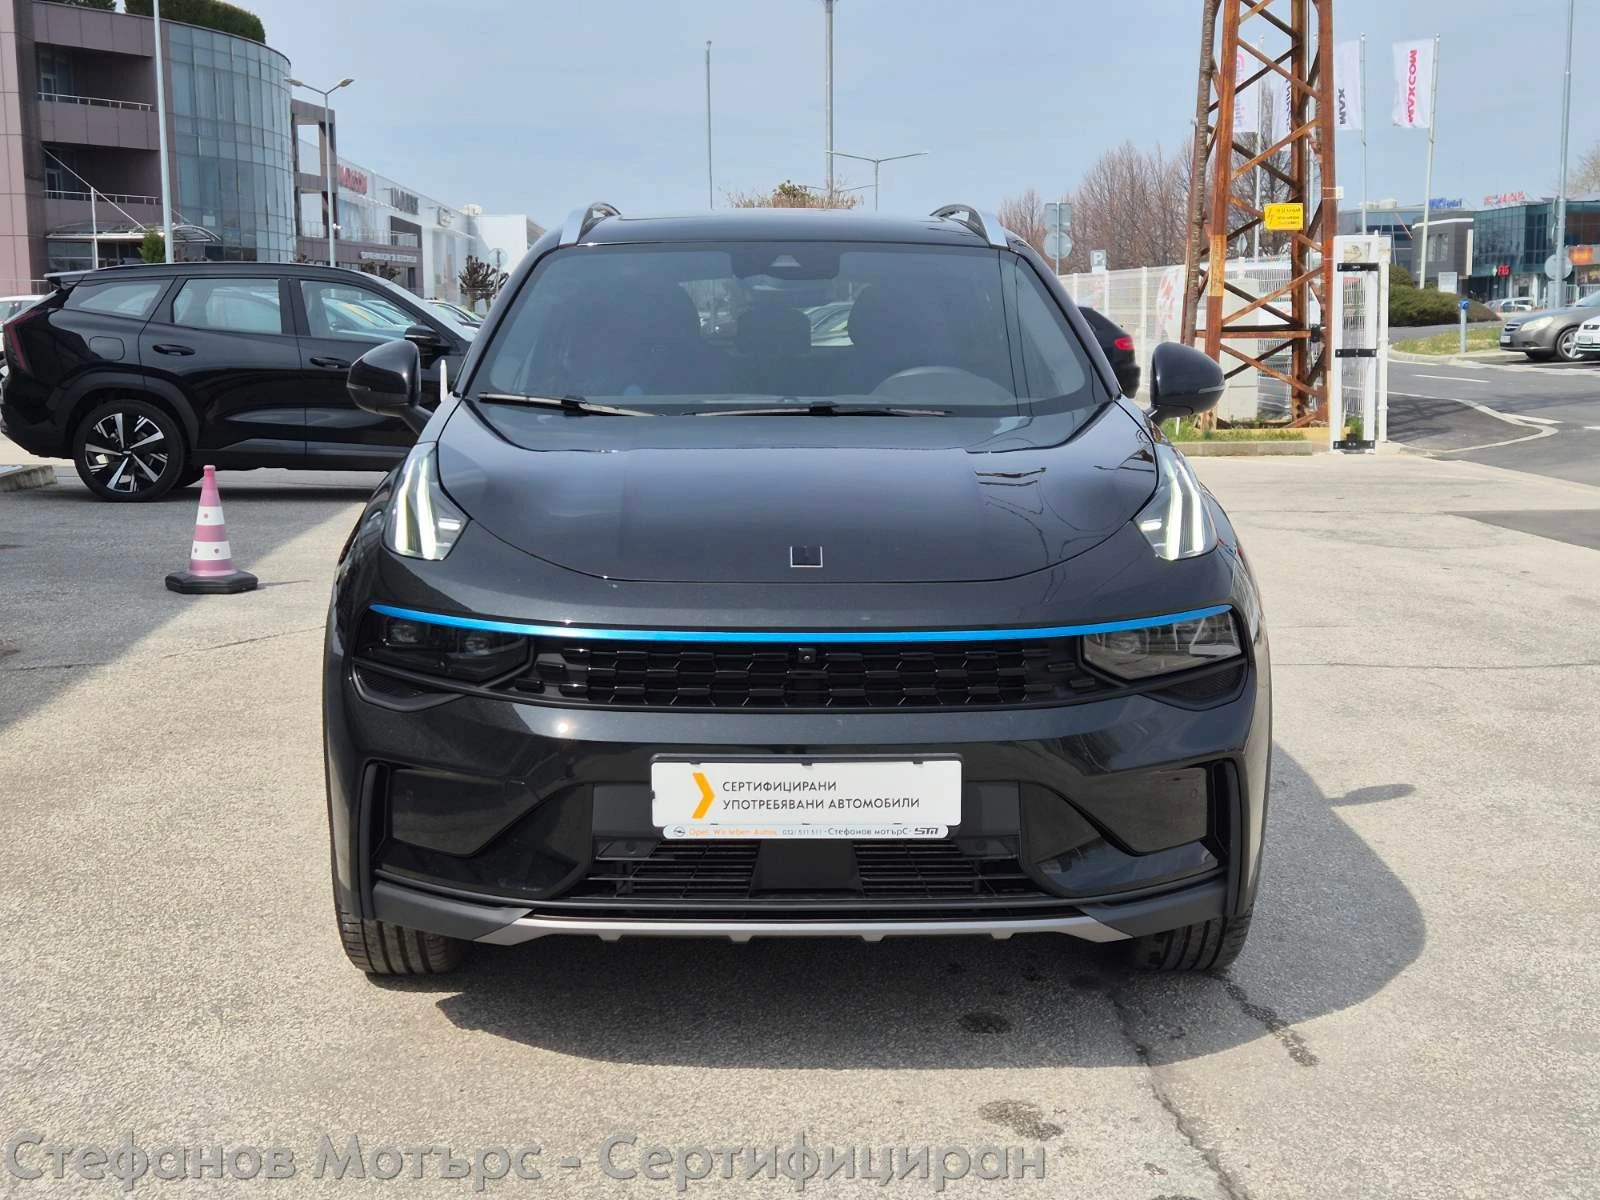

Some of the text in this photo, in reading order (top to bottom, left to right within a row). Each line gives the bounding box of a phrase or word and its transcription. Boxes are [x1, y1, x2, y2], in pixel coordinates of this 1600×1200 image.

[722, 780, 837, 793] СЕРТИФИЦИРАНИ
[722, 797, 921, 811] УПОТРЕБЯВАНИ АВТОМОБИЛИ
